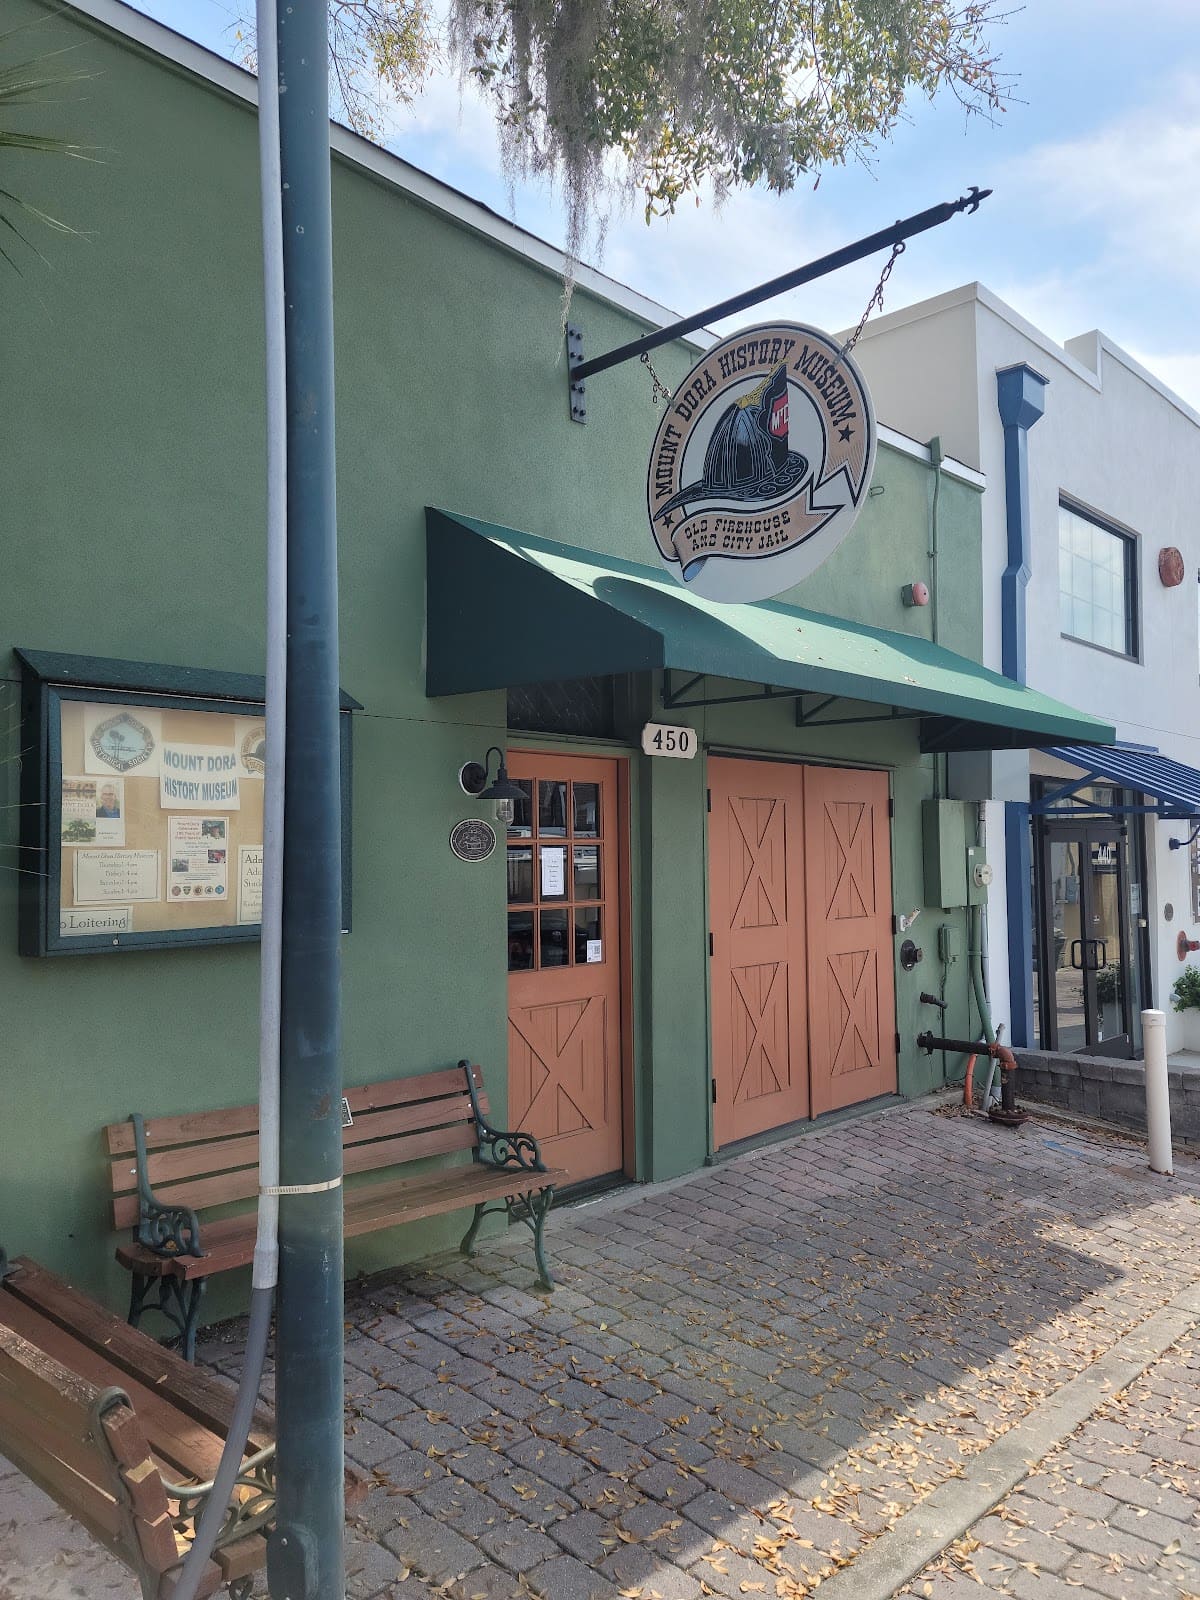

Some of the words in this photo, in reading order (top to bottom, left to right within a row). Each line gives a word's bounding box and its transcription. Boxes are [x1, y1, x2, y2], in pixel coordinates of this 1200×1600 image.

[655, 424, 682, 500] MOUNT
[675, 368, 717, 422] DORA
[718, 338, 796, 379] HISTORY
[793, 344, 857, 427] MUSEUM
[685, 519, 708, 539] OLD
[715, 510, 791, 534] FIREHOUSE
[692, 533, 717, 552] AND
[722, 535, 753, 550] CITY
[758, 529, 789, 550] JAIL
[652, 729, 689, 752] 450
[163, 748, 204, 771] MOUNT
[207, 753, 237, 772] DORA
[164, 775, 200, 800] HISTORY
[201, 777, 238, 800] MUSEUM
[1097, 845, 1112, 865] 440
[69, 915, 126, 929] Loitering
